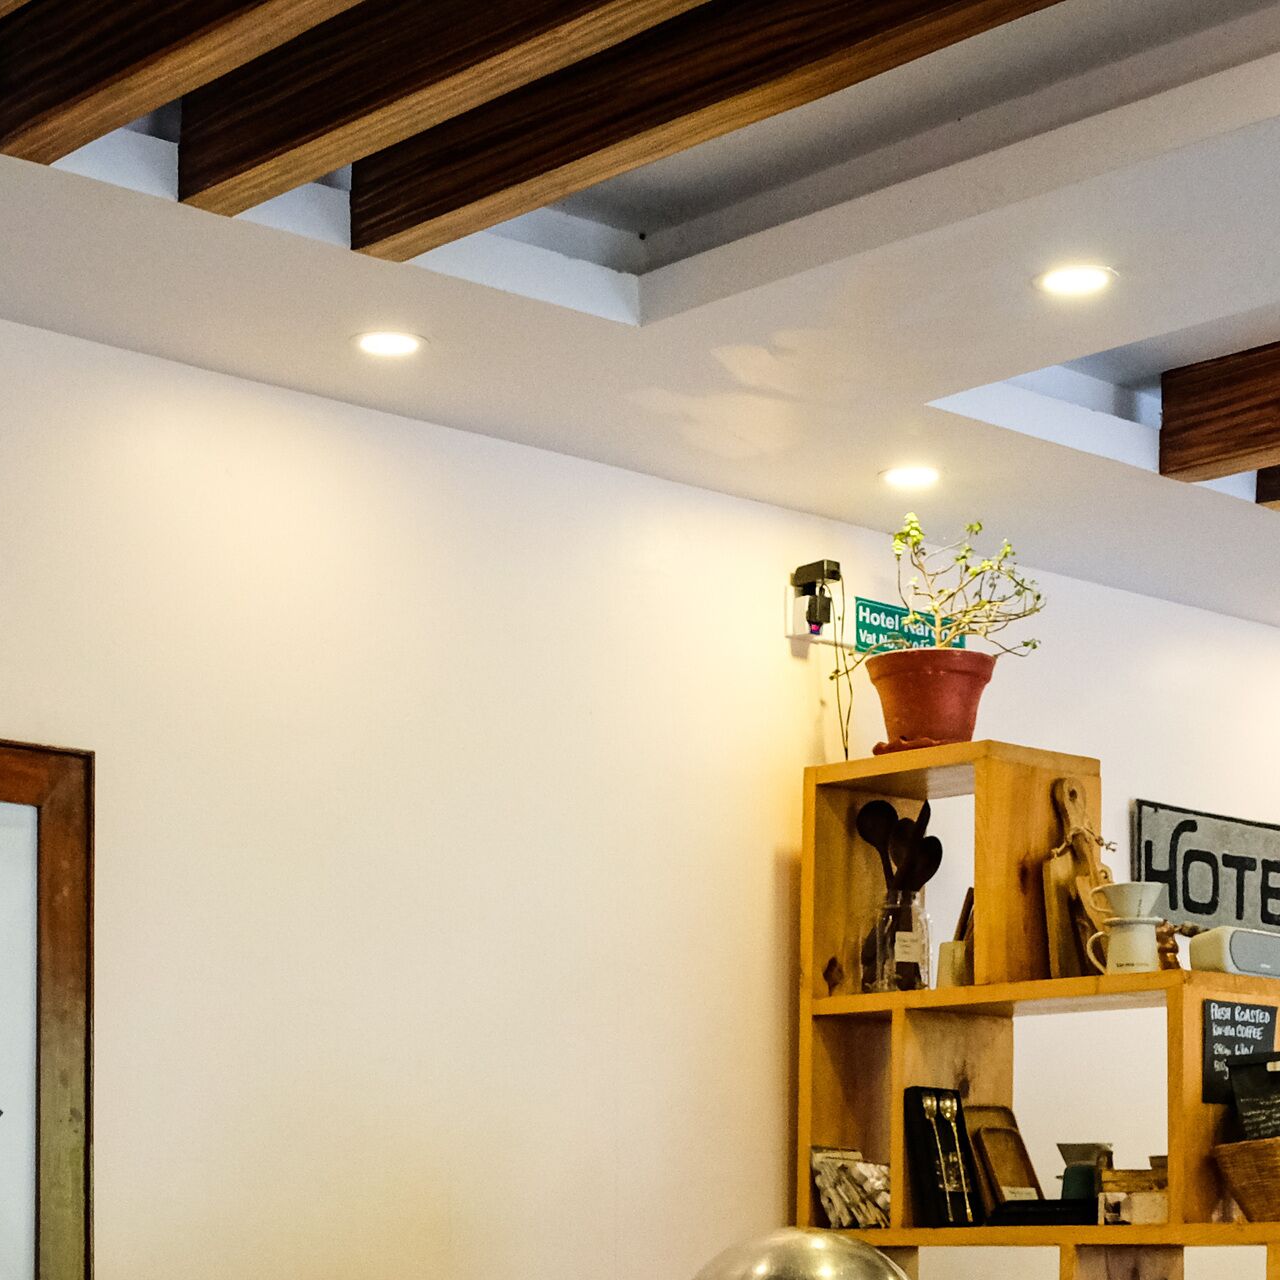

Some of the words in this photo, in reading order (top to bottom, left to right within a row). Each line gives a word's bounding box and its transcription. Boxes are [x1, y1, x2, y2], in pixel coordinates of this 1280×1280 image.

[858, 605, 900, 631] Hotel
[858, 628, 877, 647] Vat
[1234, 1005, 1271, 1024] ROASTED
[1235, 1024, 1265, 1041] COFFEE
